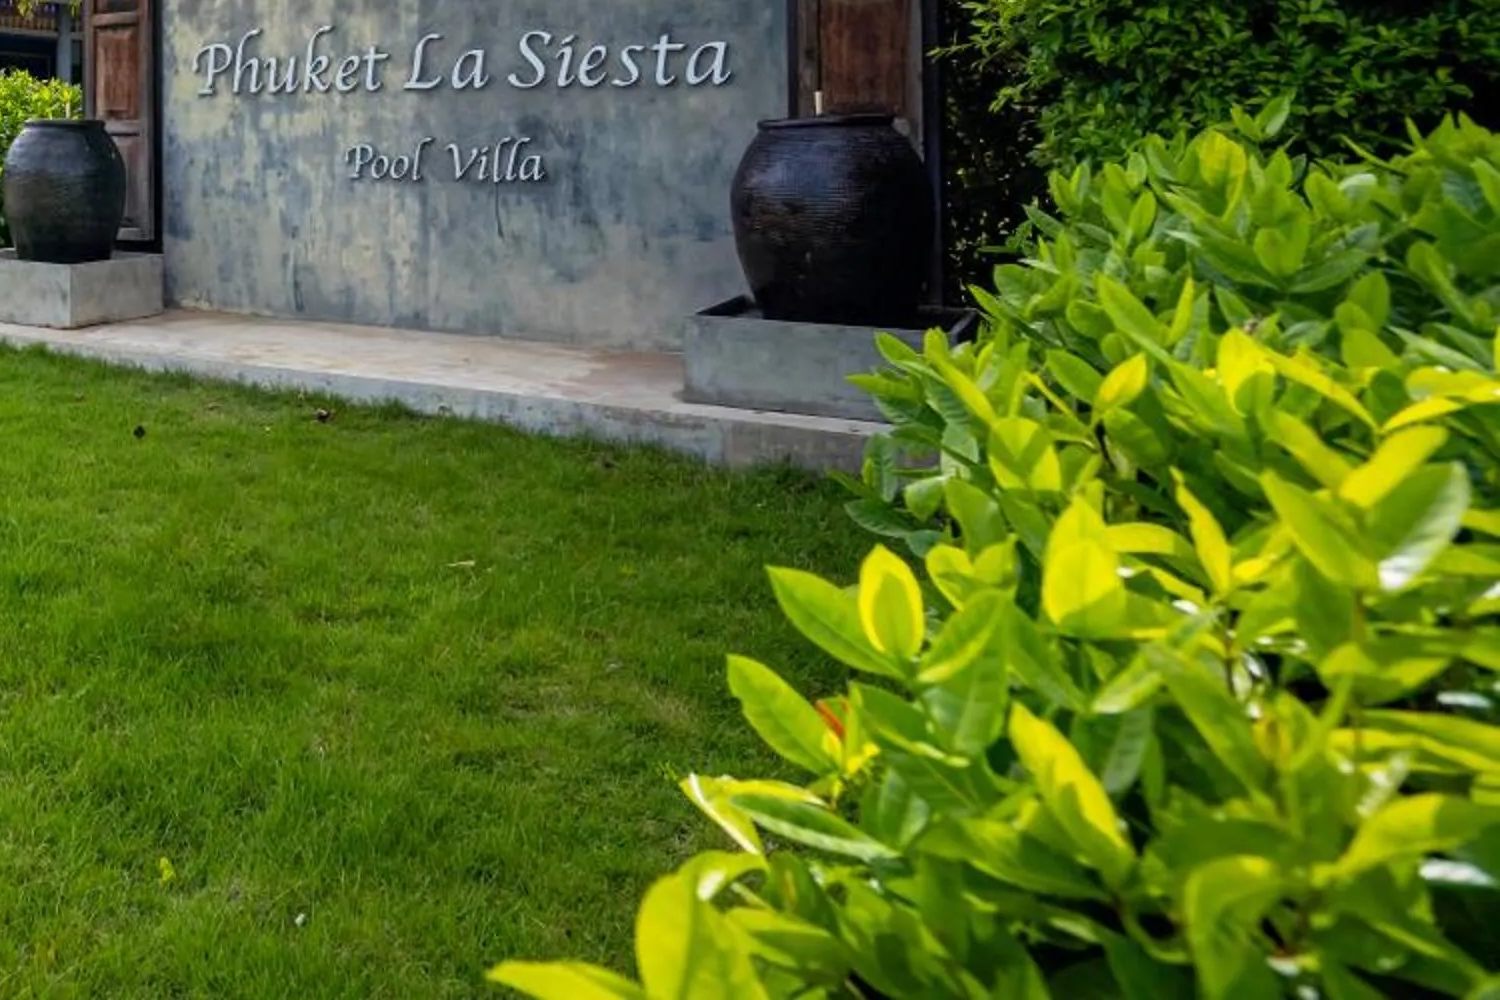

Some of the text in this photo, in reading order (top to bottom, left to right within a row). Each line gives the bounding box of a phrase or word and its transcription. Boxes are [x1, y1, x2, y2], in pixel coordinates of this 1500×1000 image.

[194, 24, 733, 96] Phuket La Siesta
[345, 137, 546, 183] Pool Villa
